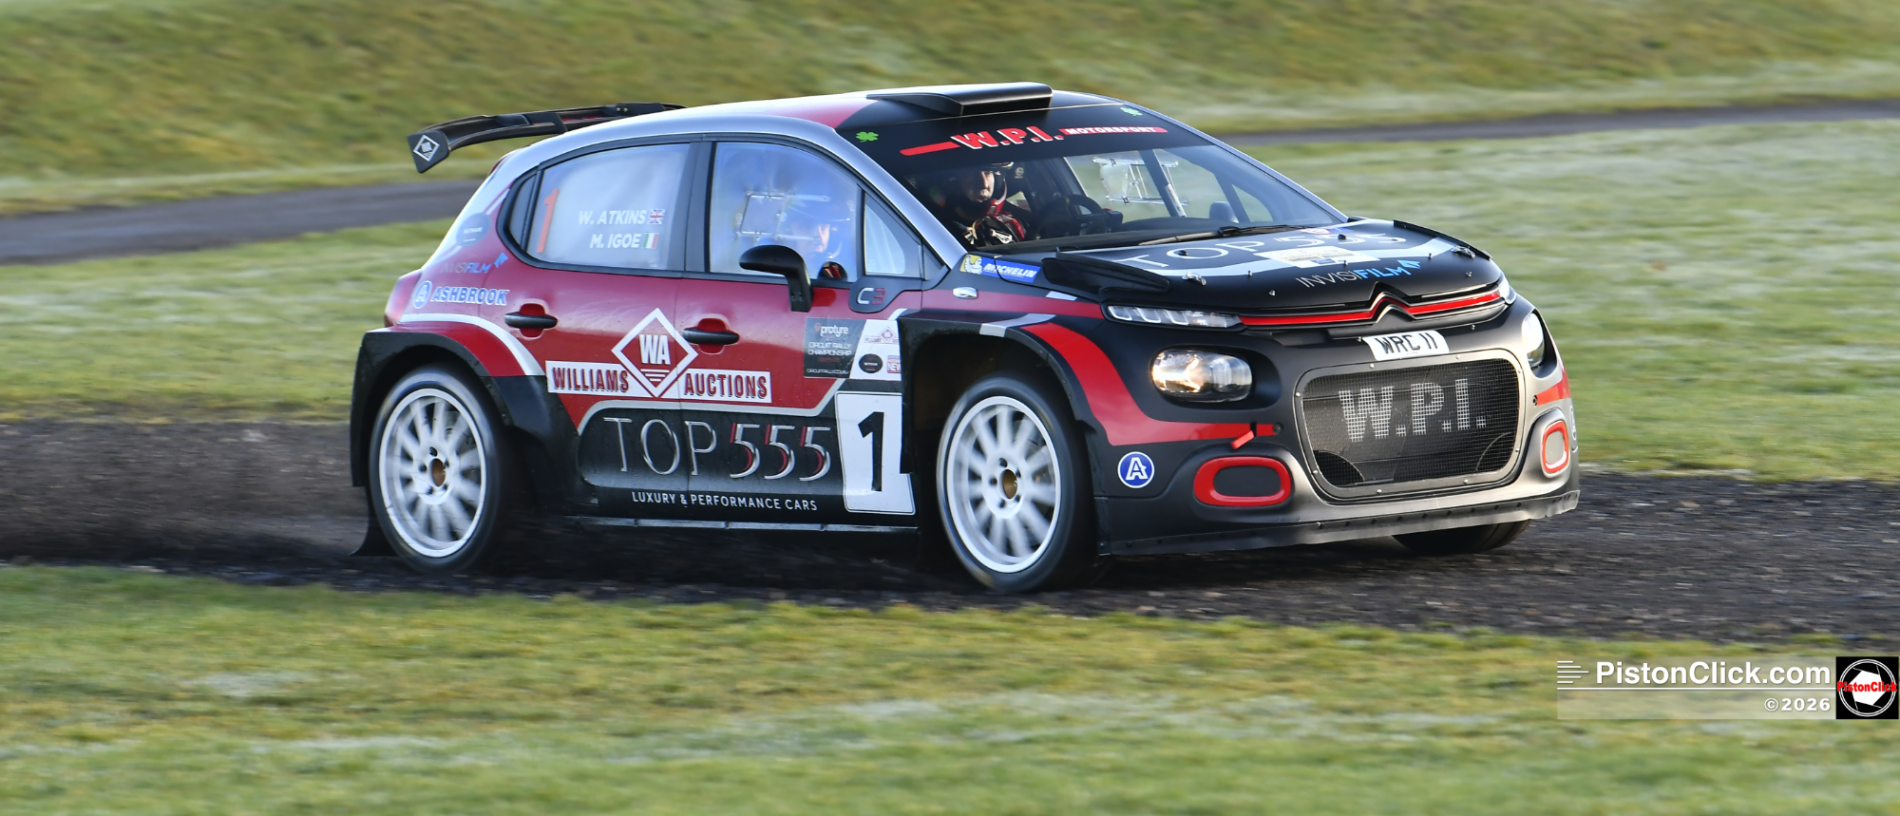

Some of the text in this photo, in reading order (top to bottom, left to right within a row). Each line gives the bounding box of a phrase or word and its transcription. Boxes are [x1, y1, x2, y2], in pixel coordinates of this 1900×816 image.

[950, 126, 1157, 149] W.P.I. MOTORSPORT
[537, 188, 559, 253] 1
[578, 210, 647, 225] W. ATKINS
[589, 233, 641, 249] M. IGOE
[1129, 240, 1265, 268] TOP
[983, 263, 1038, 278] MICHELIN
[1295, 266, 1411, 288] INVISIFILM
[430, 286, 509, 306] ASHBROOK
[857, 287, 886, 305] C3
[820, 325, 849, 337] protyre
[639, 334, 671, 365] WA
[1376, 335, 1420, 354] WRC
[552, 367, 768, 399] WILLIAMS AUCTIONS
[1338, 378, 1487, 442] W.P.I.
[603, 417, 831, 481] TOP 555
[858, 411, 885, 491] 1
[1125, 457, 1149, 480] A
[632, 491, 817, 511] LUXURY & PERFORMANCE CARS
